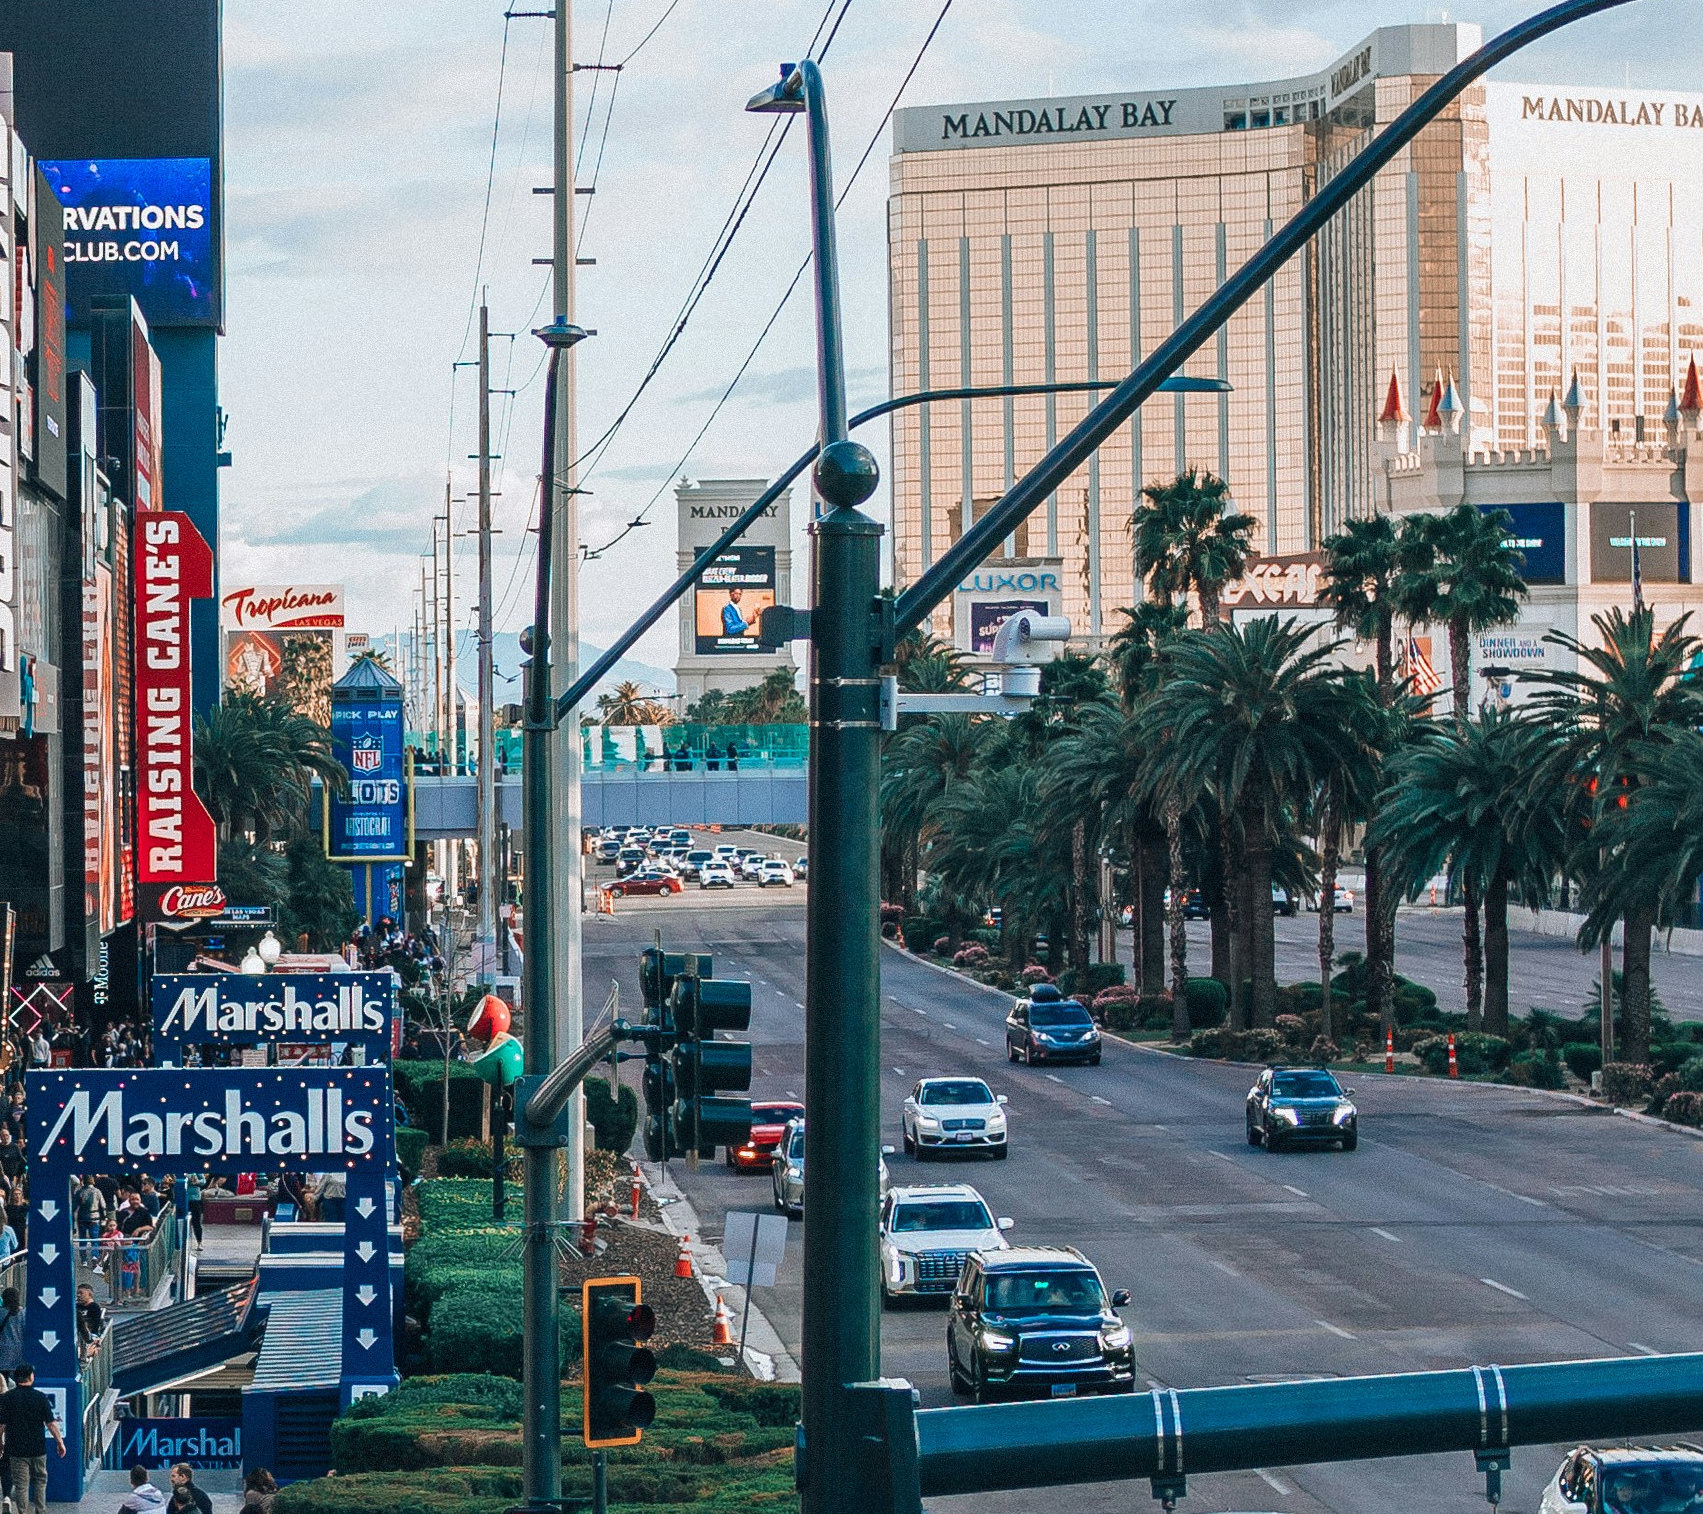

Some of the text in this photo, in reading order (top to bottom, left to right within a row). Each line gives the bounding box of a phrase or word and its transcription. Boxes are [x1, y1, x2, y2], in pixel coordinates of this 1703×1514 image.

[942, 100, 1177, 139] MANDALAY BAY
[1522, 96, 1665, 126] MANDALAY
[958, 573, 1062, 592] LUXOR
[223, 587, 337, 627] Tropicana
[294, 618, 343, 627] LAS VEGAS
[1479, 638, 1517, 648] DINNER
[1482, 648, 1545, 659] SHOWDOWN
[146, 520, 183, 873] RAISING CANE'S
[367, 710, 398, 719] PLAY
[354, 751, 380, 769] NFL
[338, 779, 400, 804] LOTS
[162, 885, 226, 916] Cane's
[25, 967, 60, 977] adidas
[161, 987, 384, 1031] Marshalls
[39, 1088, 374, 1156] Marshalls
